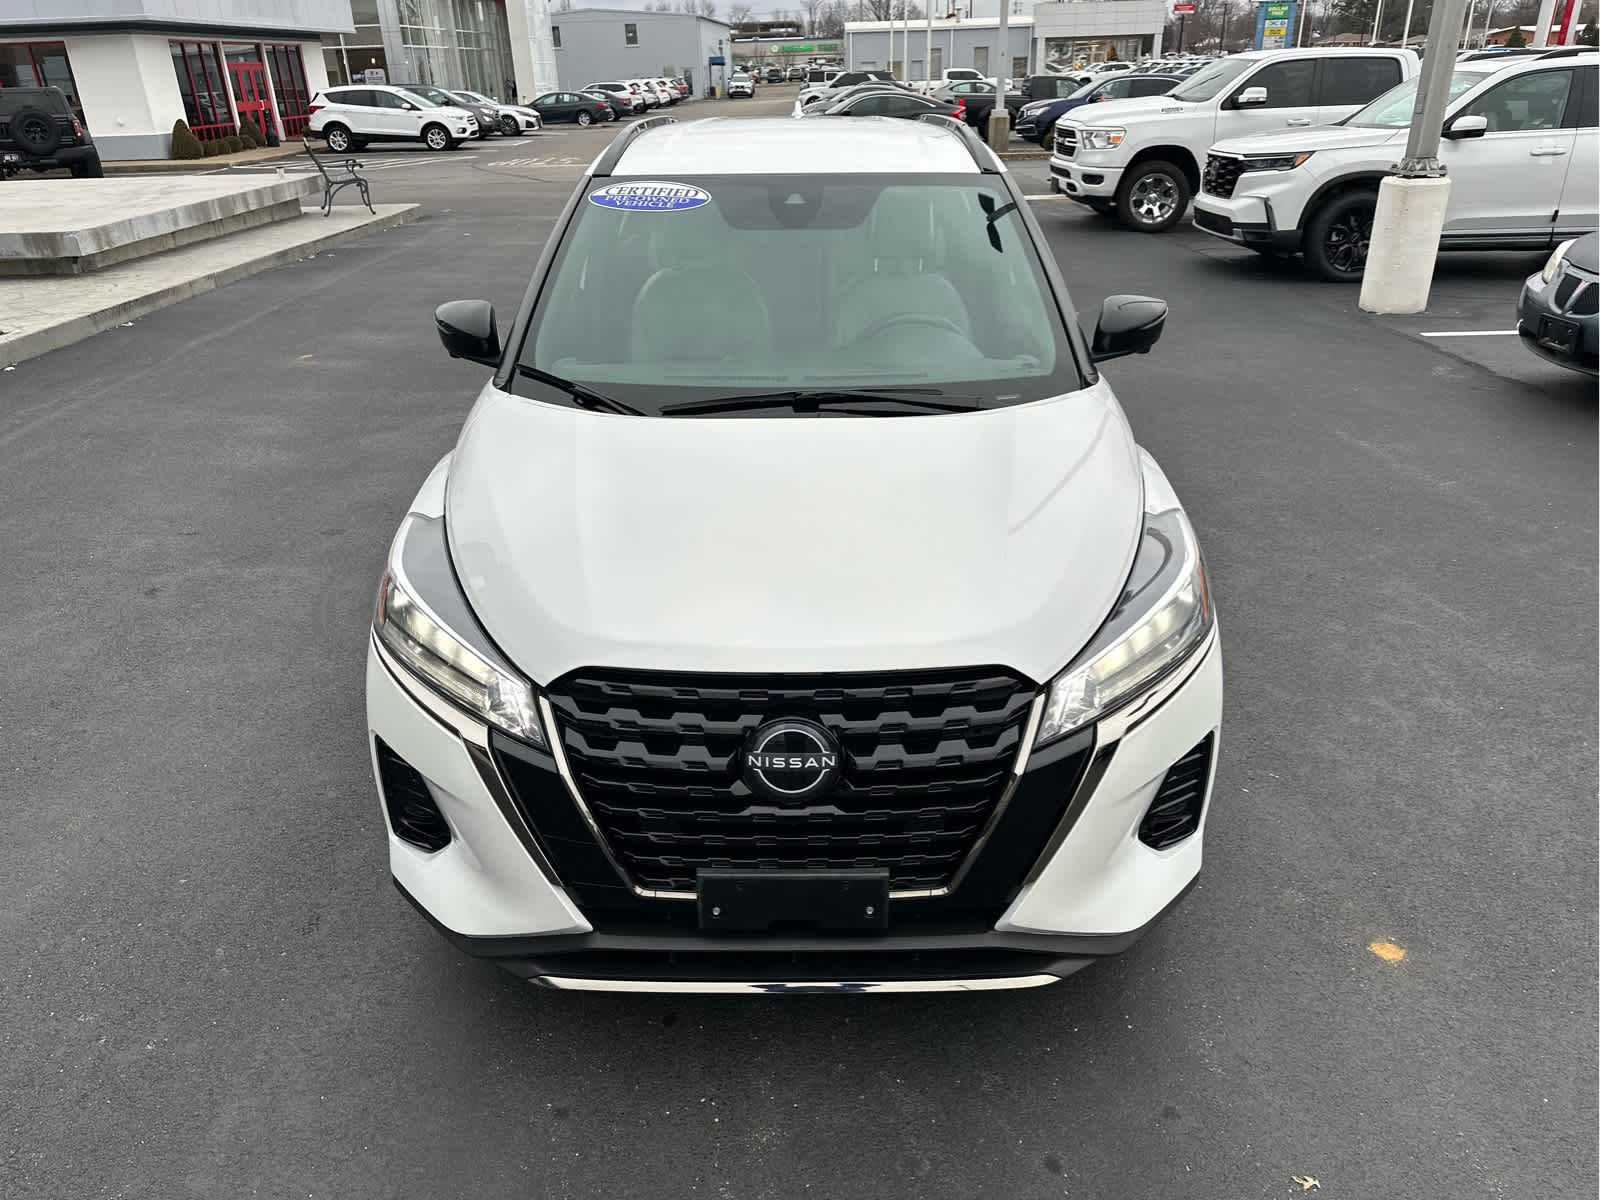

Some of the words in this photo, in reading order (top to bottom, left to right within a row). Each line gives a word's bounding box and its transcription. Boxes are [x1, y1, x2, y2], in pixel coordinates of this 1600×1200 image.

[605, 186, 699, 198] CERTIFIED
[605, 195, 690, 204] PRE-OWNED
[615, 200, 675, 208] VEHICLE
[748, 755, 836, 768] NISSAN
